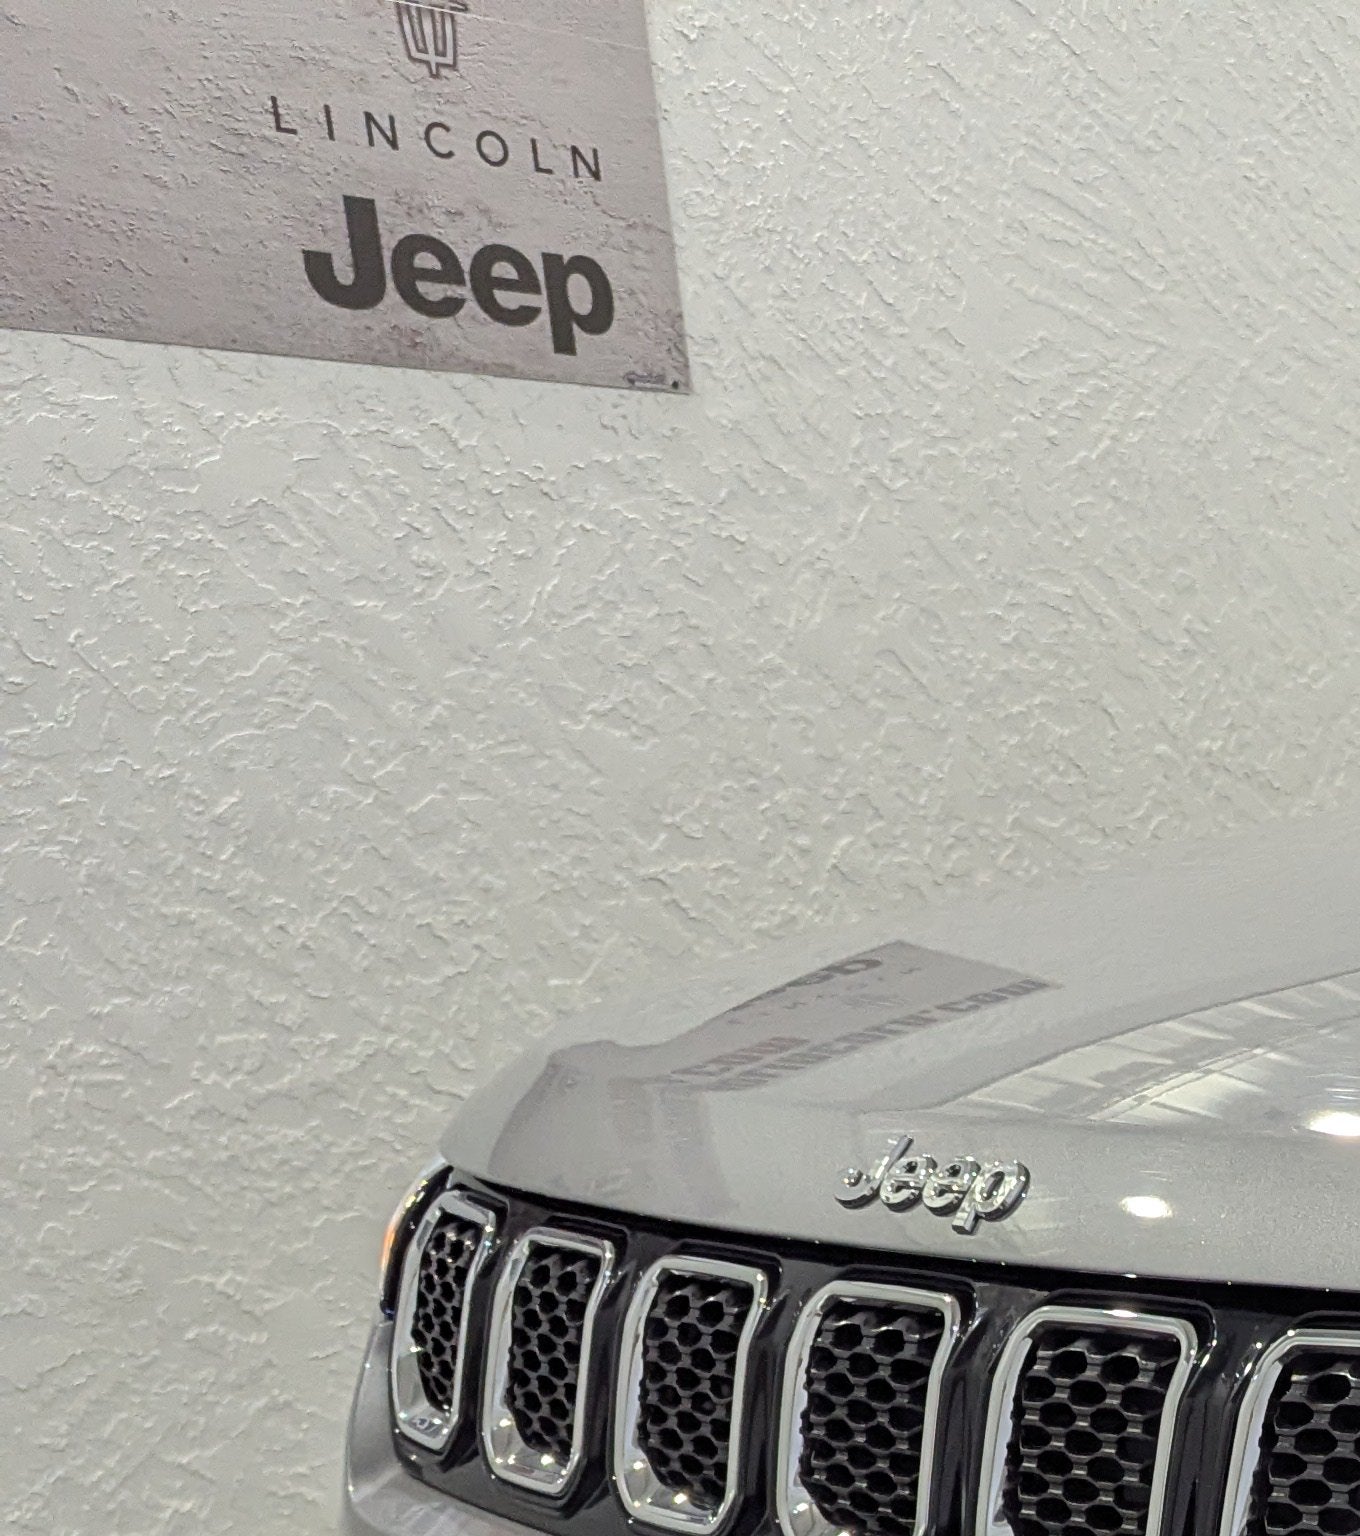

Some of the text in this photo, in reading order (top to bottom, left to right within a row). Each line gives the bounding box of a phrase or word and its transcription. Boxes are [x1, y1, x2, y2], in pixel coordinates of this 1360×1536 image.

[269, 95, 603, 182] LINCOLN
[302, 194, 615, 357] Jeep
[834, 1134, 1031, 1236] Jeep
